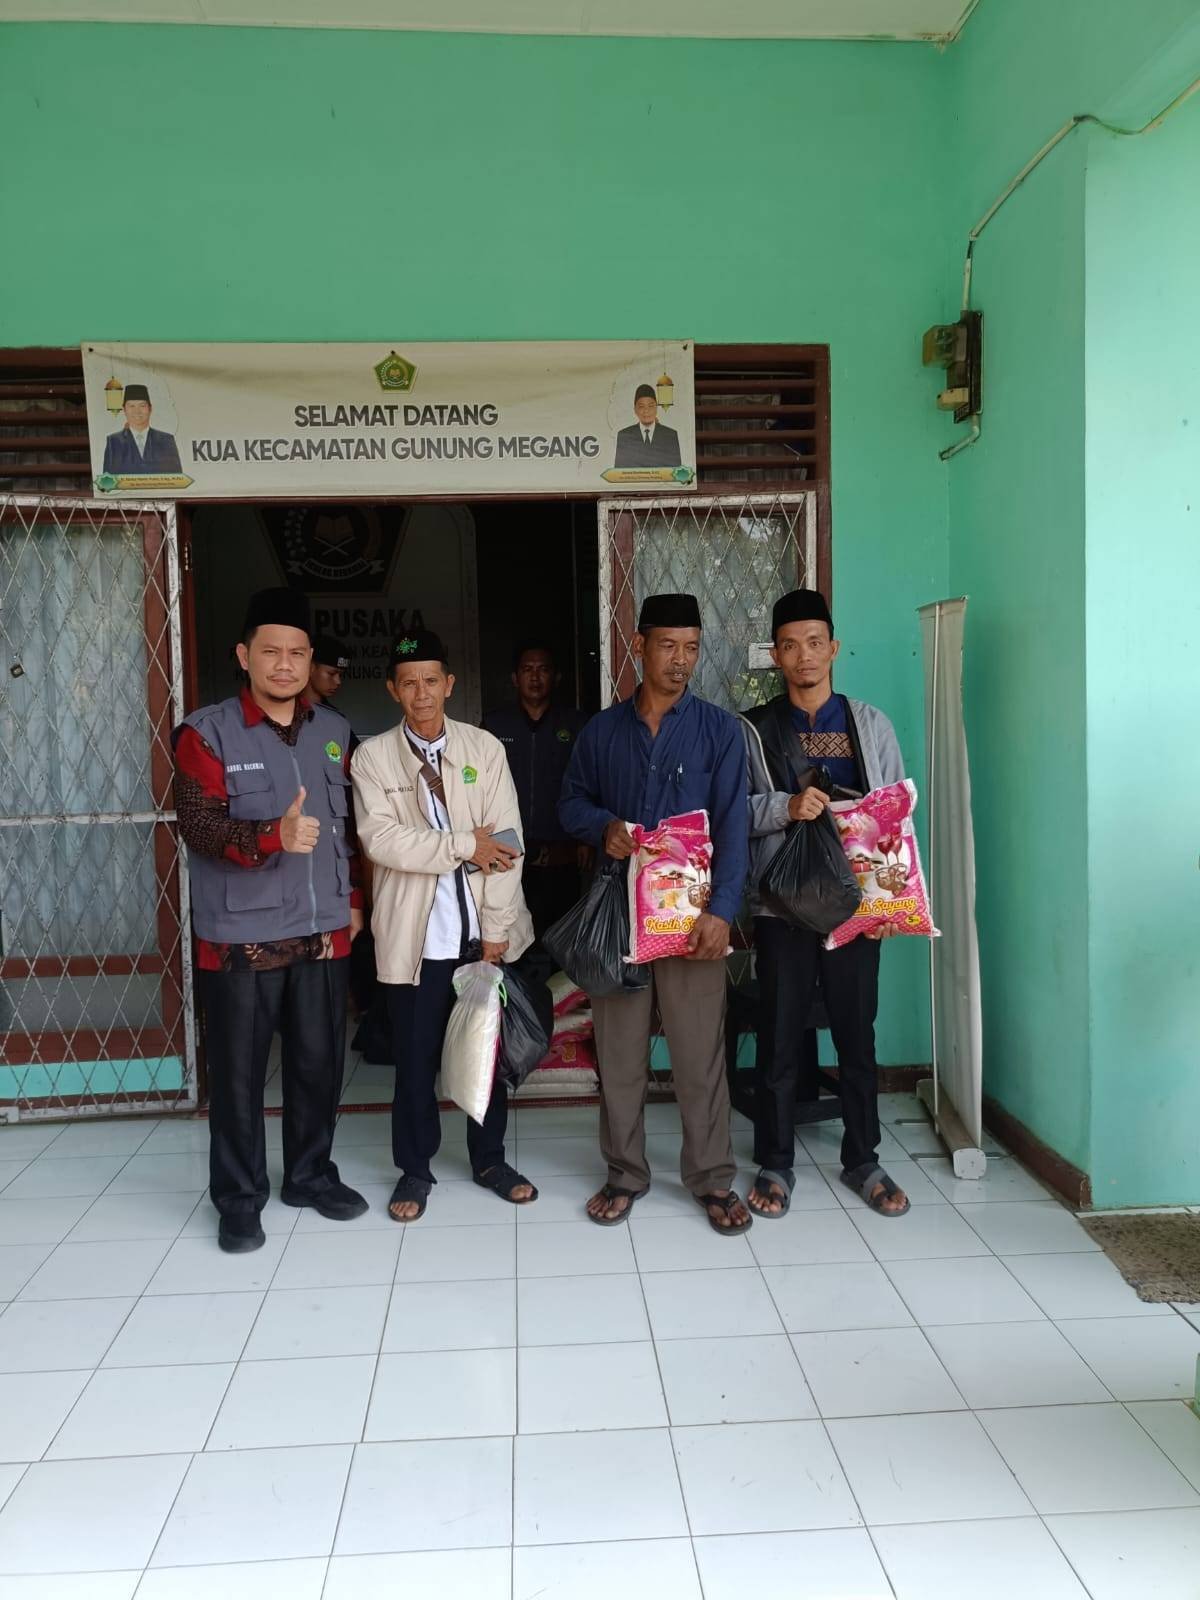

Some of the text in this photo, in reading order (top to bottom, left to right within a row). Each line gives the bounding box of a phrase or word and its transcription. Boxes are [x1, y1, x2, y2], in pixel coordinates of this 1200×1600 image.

[294, 405, 498, 427] SELAMAT DATANG
[192, 435, 600, 462] KUA KECAMATAN GUNUNG MEGANG
[315, 609, 425, 637] PUSAKA
[872, 897, 916, 915] Sayang
[645, 915, 680, 934] Kasih
